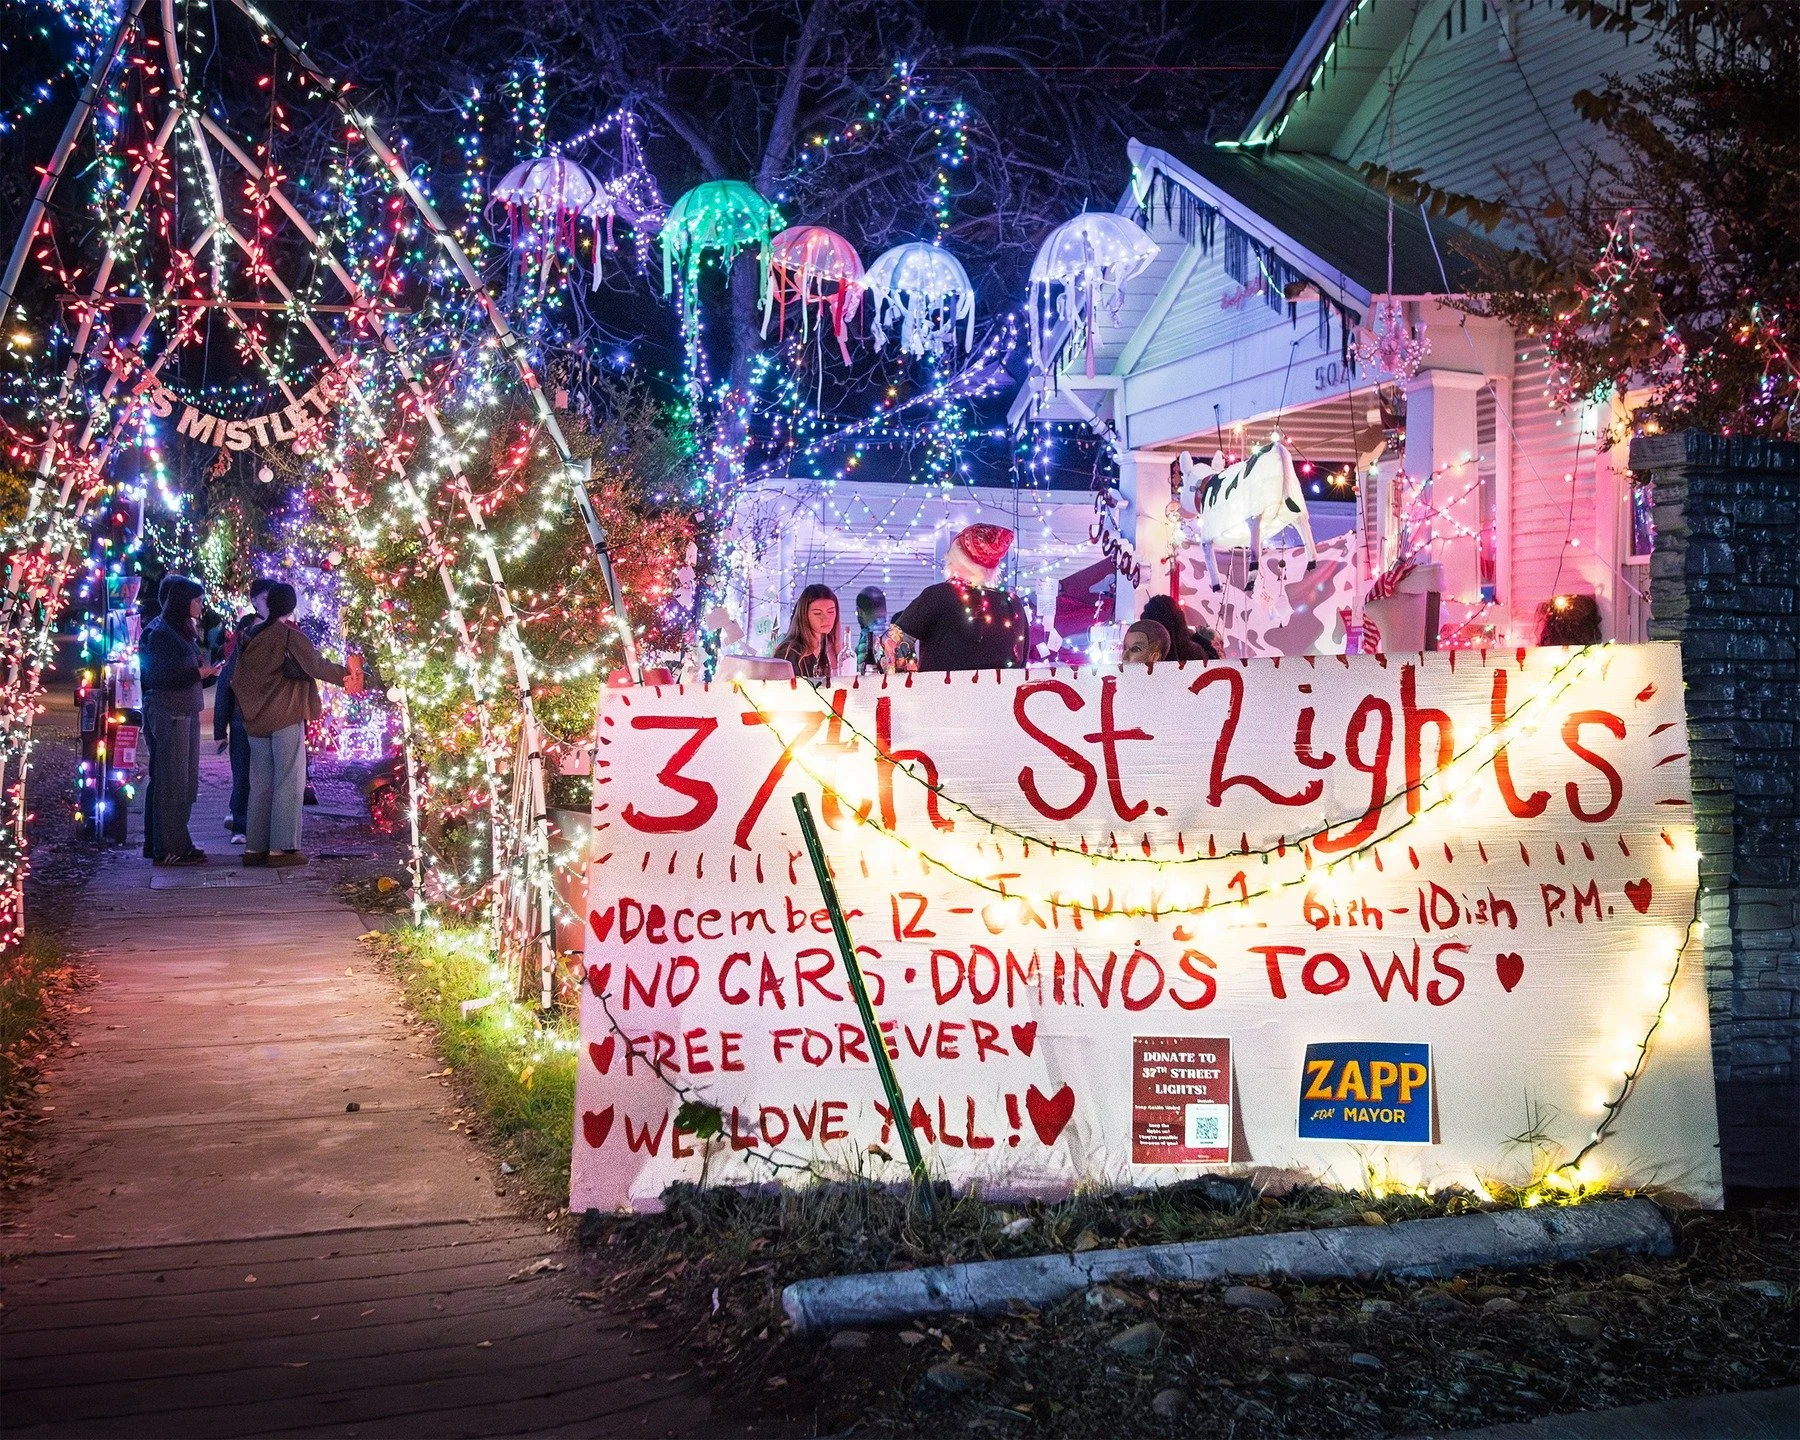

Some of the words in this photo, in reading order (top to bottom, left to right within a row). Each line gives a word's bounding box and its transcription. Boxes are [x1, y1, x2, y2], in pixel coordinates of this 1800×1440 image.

[621, 689, 955, 850] 37th
[1013, 675, 1169, 822] St.
[1188, 662, 1626, 853] Lights
[619, 896, 864, 944] December
[891, 892, 936, 942] 12
[1540, 879, 1614, 928] P.M.
[622, 956, 699, 1010] NO
[718, 946, 885, 1010] CARS
[1246, 939, 1472, 1009] TOWS
[625, 1027, 746, 1077] FREE
[772, 1018, 1009, 1067] FOREVER
[1142, 1066, 1167, 1078] 37TH
[1170, 1068, 1221, 1079] STREET
[1143, 1051, 1195, 1063] DONATE
[1198, 1052, 1217, 1063] TO
[1155, 1083, 1207, 1095] LIGHTS!
[1304, 1060, 1428, 1104] ZAPP
[625, 1108, 696, 1158] WE
[731, 1097, 849, 1151] LOVE
[1343, 1107, 1406, 1123] MAYOR
